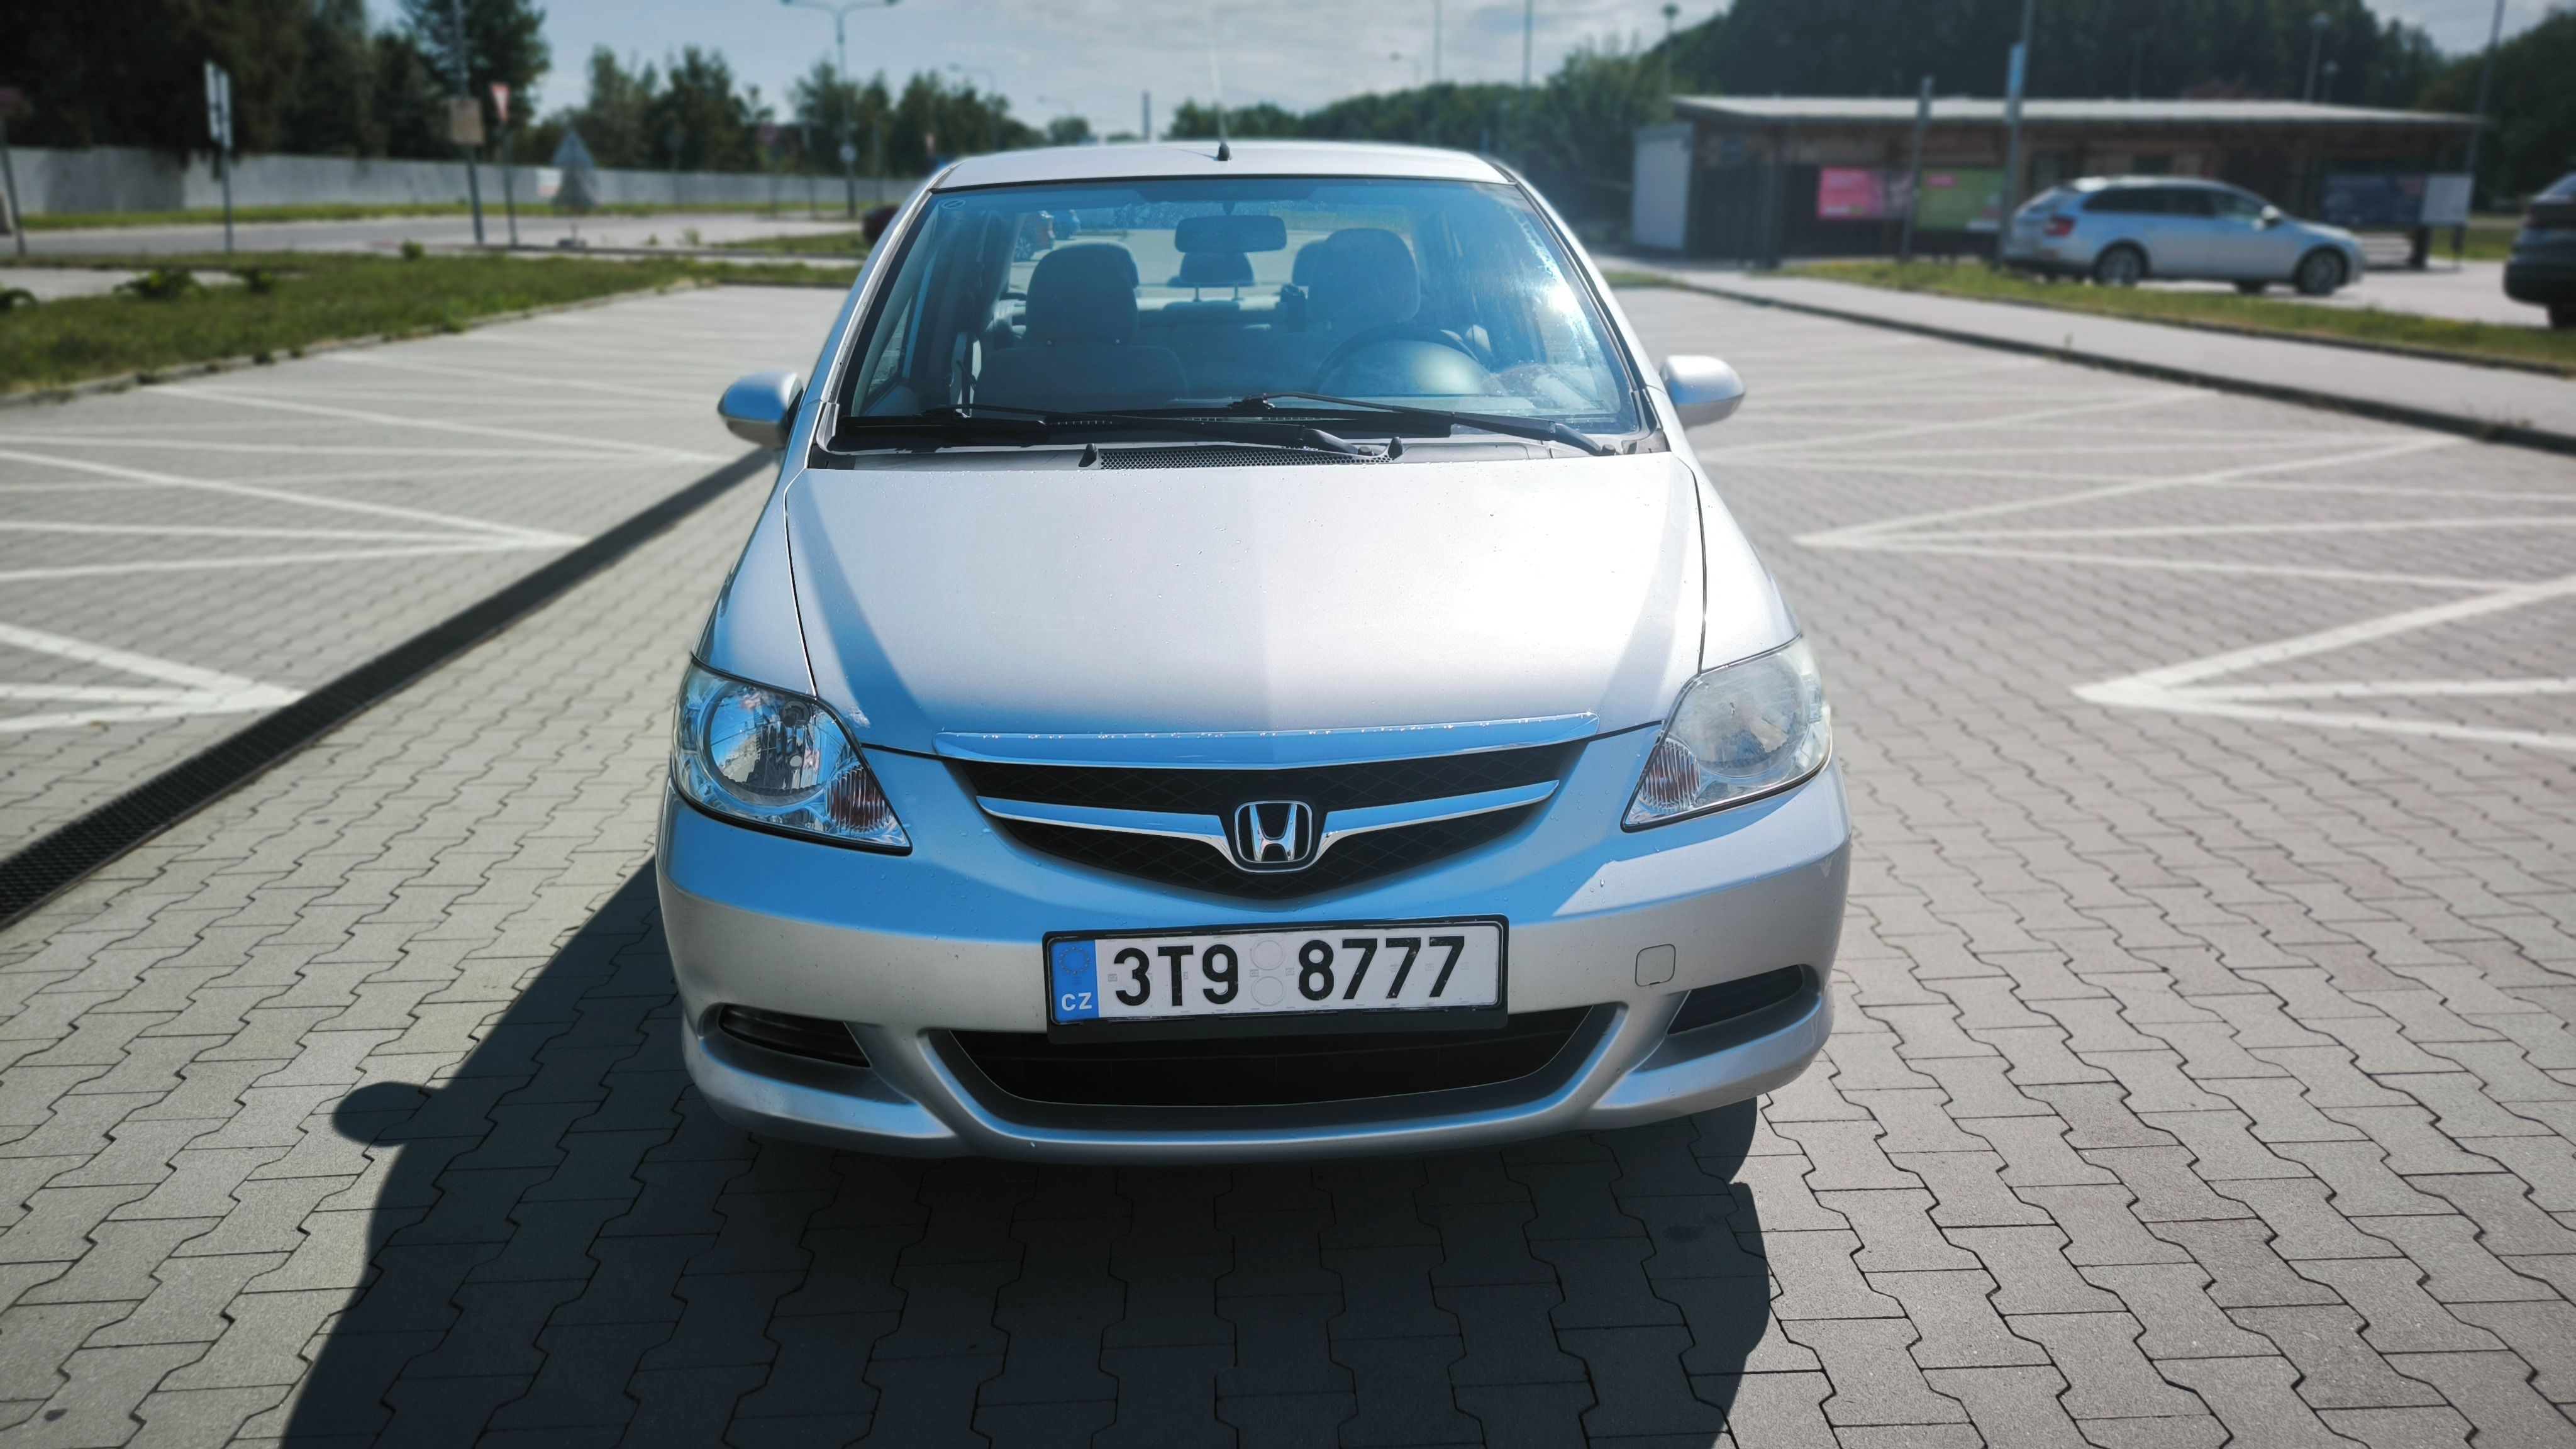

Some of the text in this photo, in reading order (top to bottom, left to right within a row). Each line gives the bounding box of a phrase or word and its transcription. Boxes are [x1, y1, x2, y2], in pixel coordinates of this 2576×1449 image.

[1113, 935, 1465, 1007] 3T9 8777
[1061, 992, 1092, 1011] CZ
